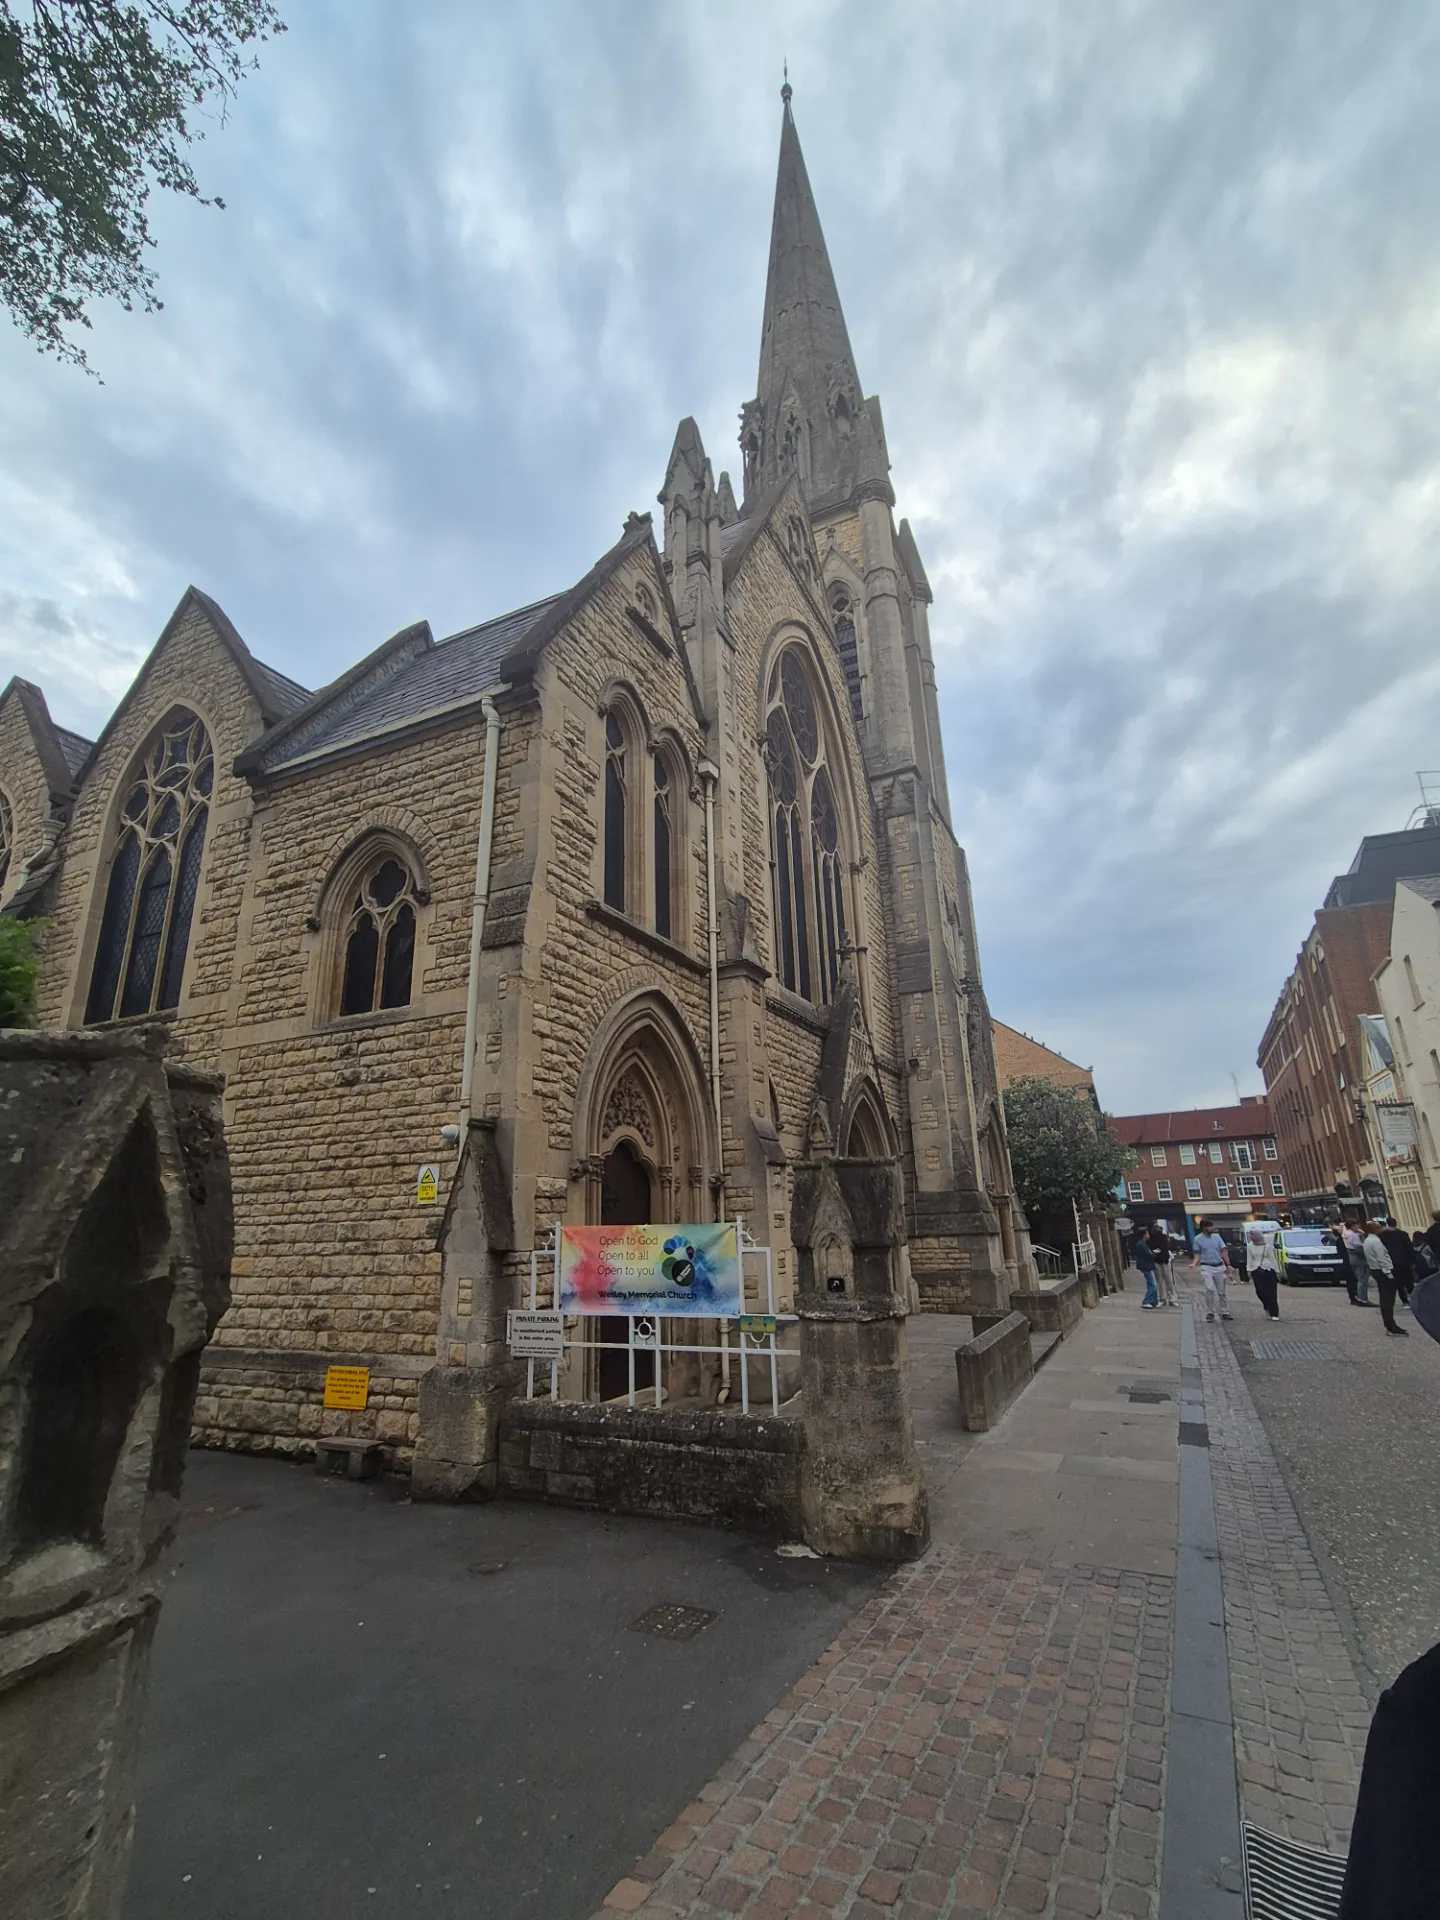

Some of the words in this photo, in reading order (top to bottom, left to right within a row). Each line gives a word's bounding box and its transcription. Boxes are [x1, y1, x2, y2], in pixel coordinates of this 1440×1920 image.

[599, 1236, 624, 1247] Open
[626, 1237, 636, 1246] to
[638, 1235, 658, 1246] God
[598, 1250, 624, 1262] Open
[626, 1252, 635, 1261] to
[637, 1250, 649, 1261] all
[597, 1265, 623, 1277] Open
[625, 1266, 635, 1276] to
[636, 1267, 655, 1278] you
[598, 1290, 627, 1300] Wesley
[628, 1290, 666, 1299] Memorial
[667, 1290, 697, 1299] Church
